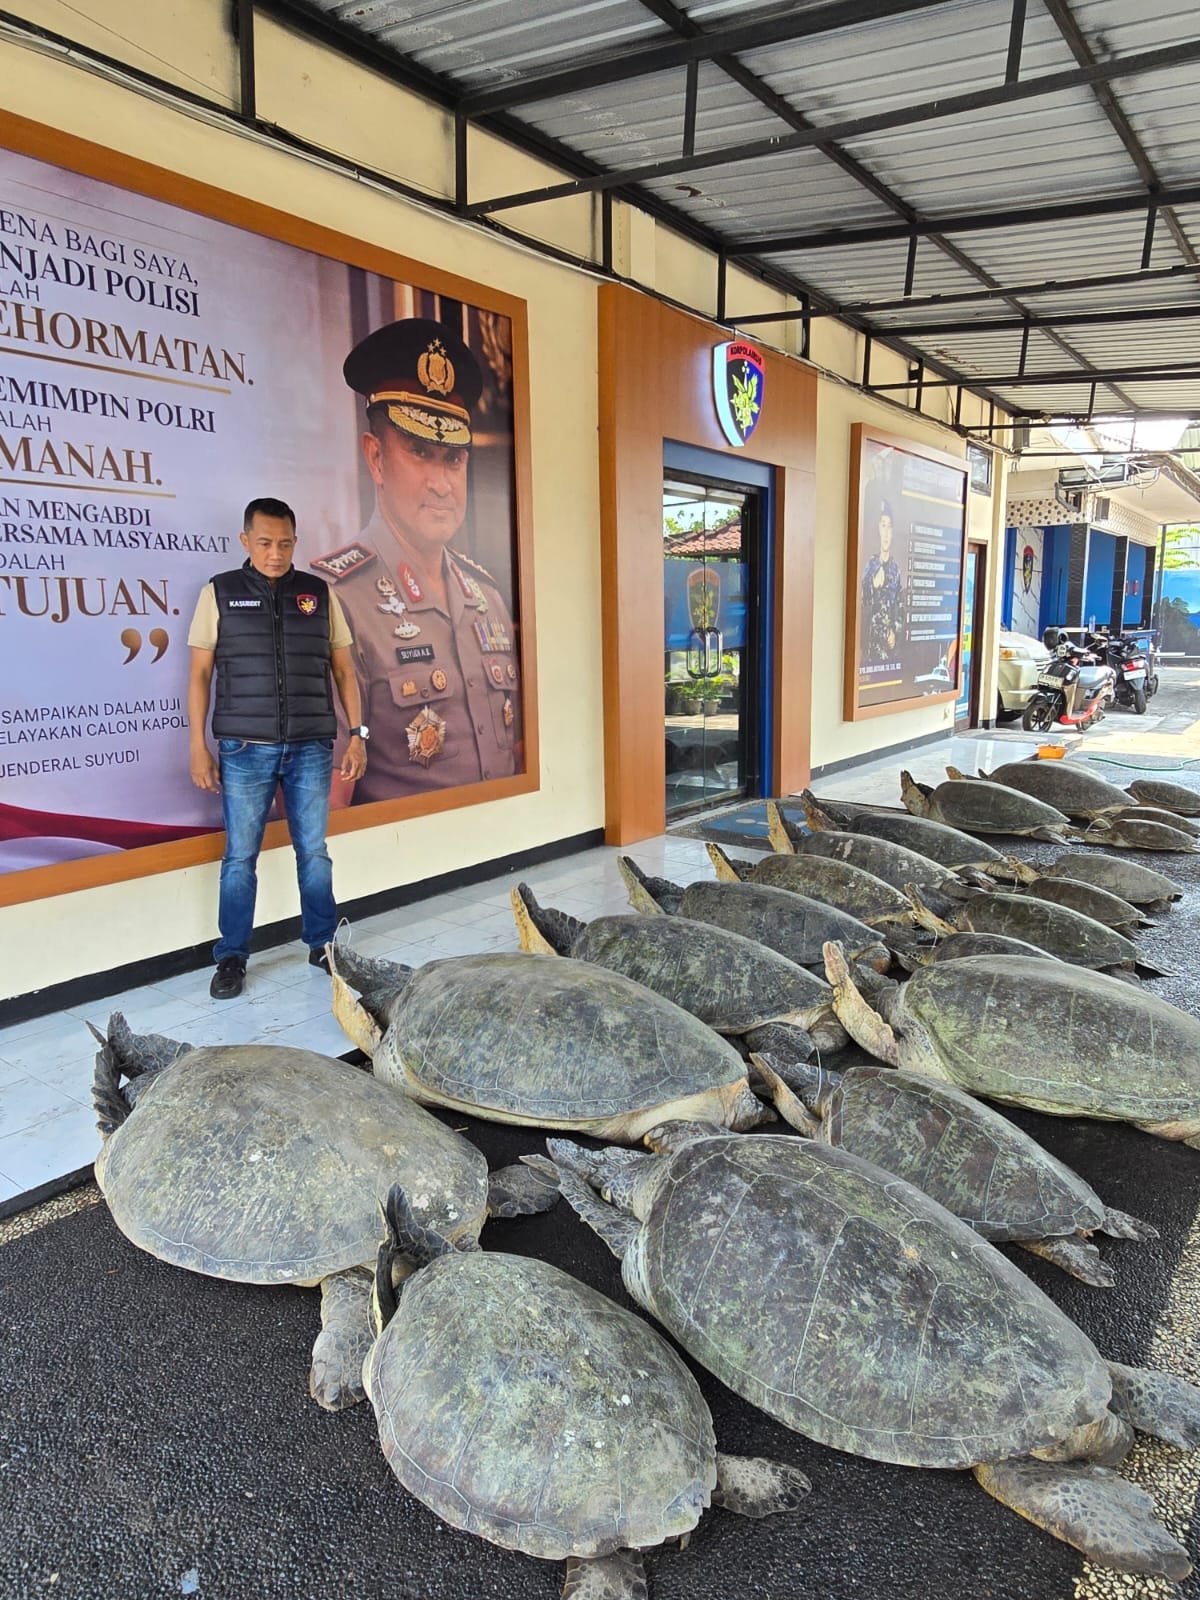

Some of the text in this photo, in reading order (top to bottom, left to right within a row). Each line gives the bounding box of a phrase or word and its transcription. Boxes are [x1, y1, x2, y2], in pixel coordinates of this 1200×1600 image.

[0, 210, 198, 287] ENA BAGI SAYA,
[0, 241, 200, 317] NJADI POLISI
[136, 398, 216, 433] POLRI
[26, 498, 152, 527] MENGABDI
[0, 521, 230, 554] RSAMA MASYARAKAT
[1, 698, 180, 725] SAMPAIKAN DALAM UJI
[86, 721, 138, 737] CALON
[0, 750, 140, 778] JENDERAL SUYUDI
